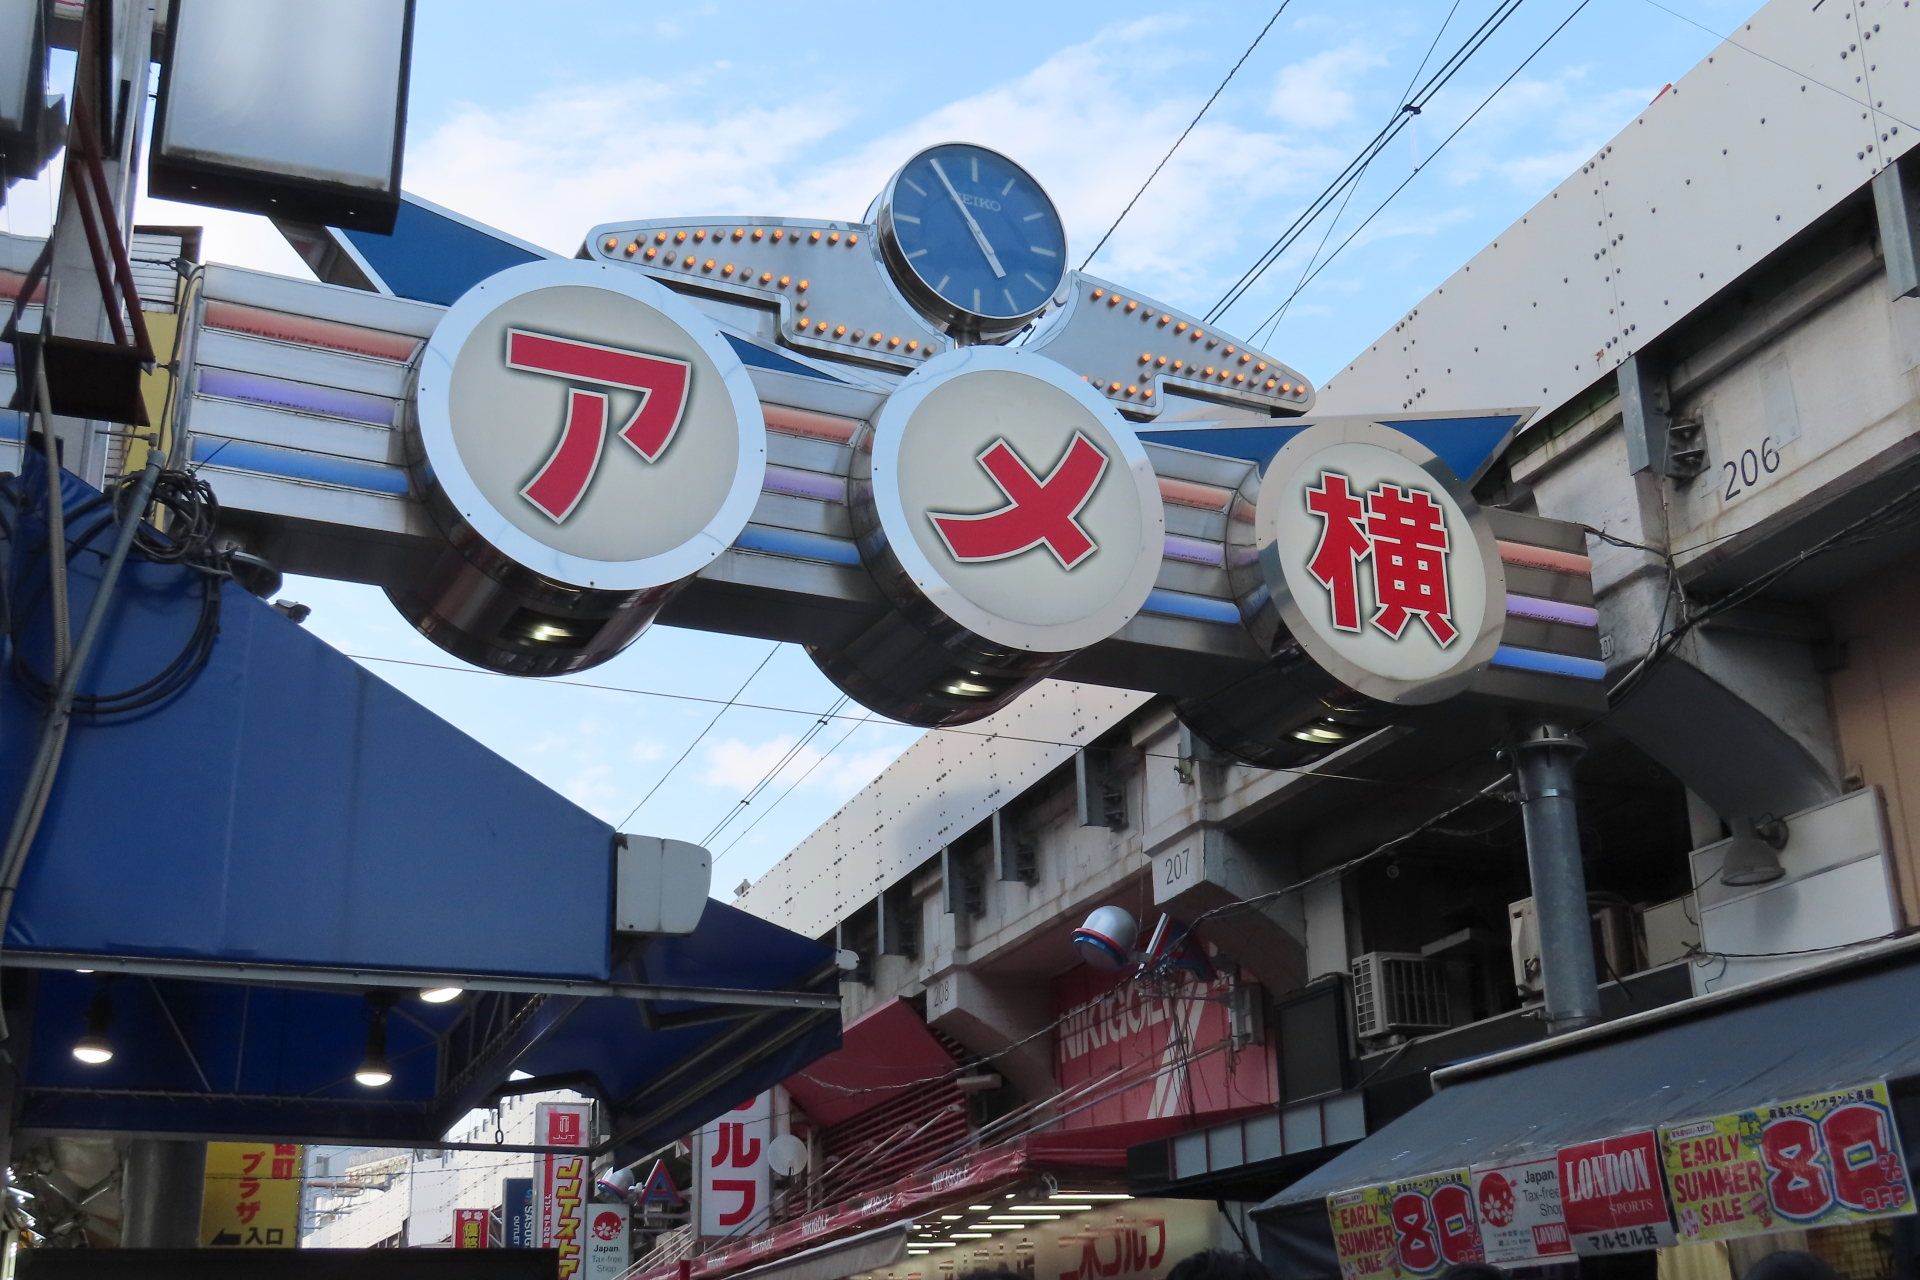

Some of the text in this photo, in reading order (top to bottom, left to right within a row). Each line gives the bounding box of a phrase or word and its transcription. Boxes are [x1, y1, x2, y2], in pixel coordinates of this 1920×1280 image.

[1723, 436, 1780, 501] 206
[1165, 847, 1190, 885] 207
[933, 980, 950, 1008] 208
[711, 1095, 761, 1226] ルフ
[1679, 1133, 1739, 1169] EARLY
[236, 1151, 265, 1225] プラザ
[1565, 1147, 1652, 1203] LONDON
[1673, 1160, 1764, 1204] SUMMER
[1522, 1186, 1560, 1203] Tax-free
[1609, 1198, 1654, 1215] SPORTS
[524, 1205, 533, 1248] SASUG
[1340, 1203, 1379, 1229] EARLY
[1701, 1197, 1745, 1227] SALE
[245, 1227, 284, 1246] 入口
[1338, 1225, 1396, 1257] SUMMER
[1534, 1224, 1567, 1245] LONDON
[1588, 1225, 1659, 1250] マルセル店
[592, 1254, 623, 1263] Tax-free
[596, 1264, 617, 1273] Shop
[1357, 1253, 1384, 1276] SALE
